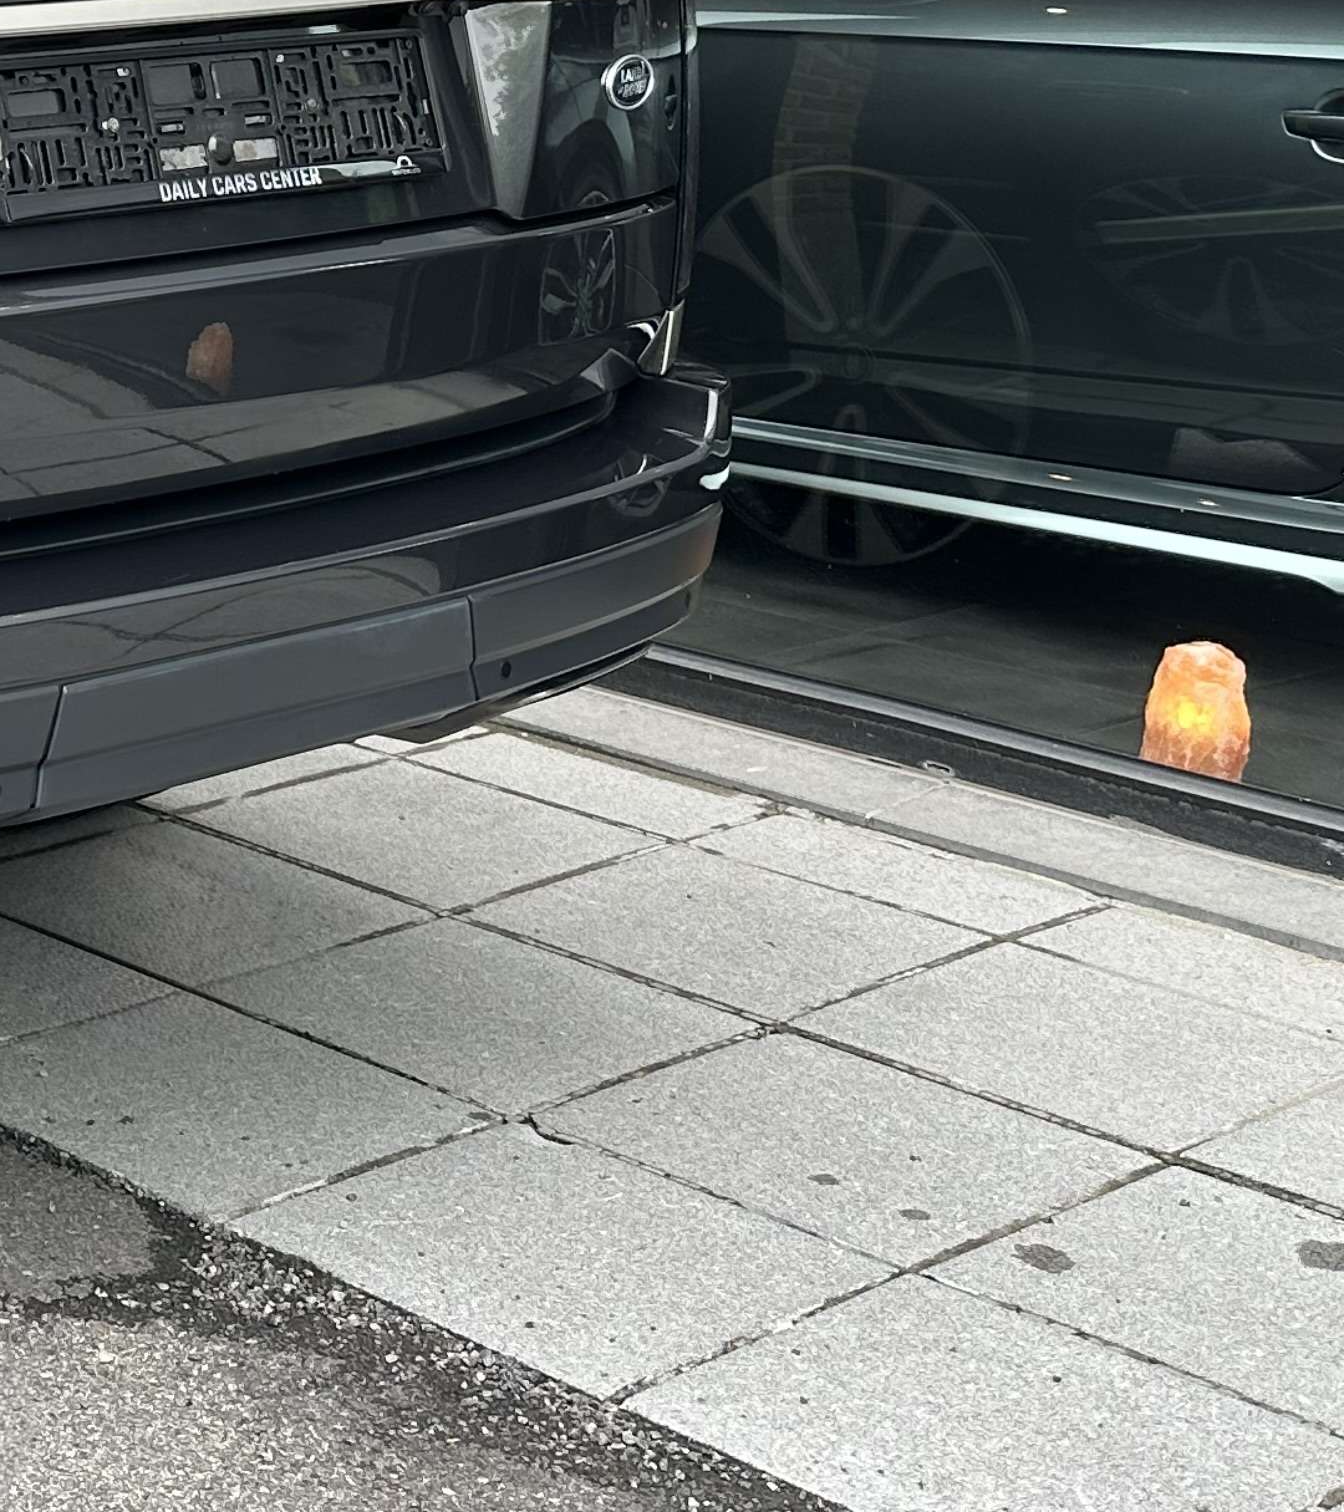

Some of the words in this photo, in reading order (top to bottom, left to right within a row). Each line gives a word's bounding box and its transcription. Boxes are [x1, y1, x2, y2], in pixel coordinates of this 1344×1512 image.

[158, 178, 208, 203] DAILY
[211, 172, 258, 196] CARS
[260, 167, 323, 190] CENTER
